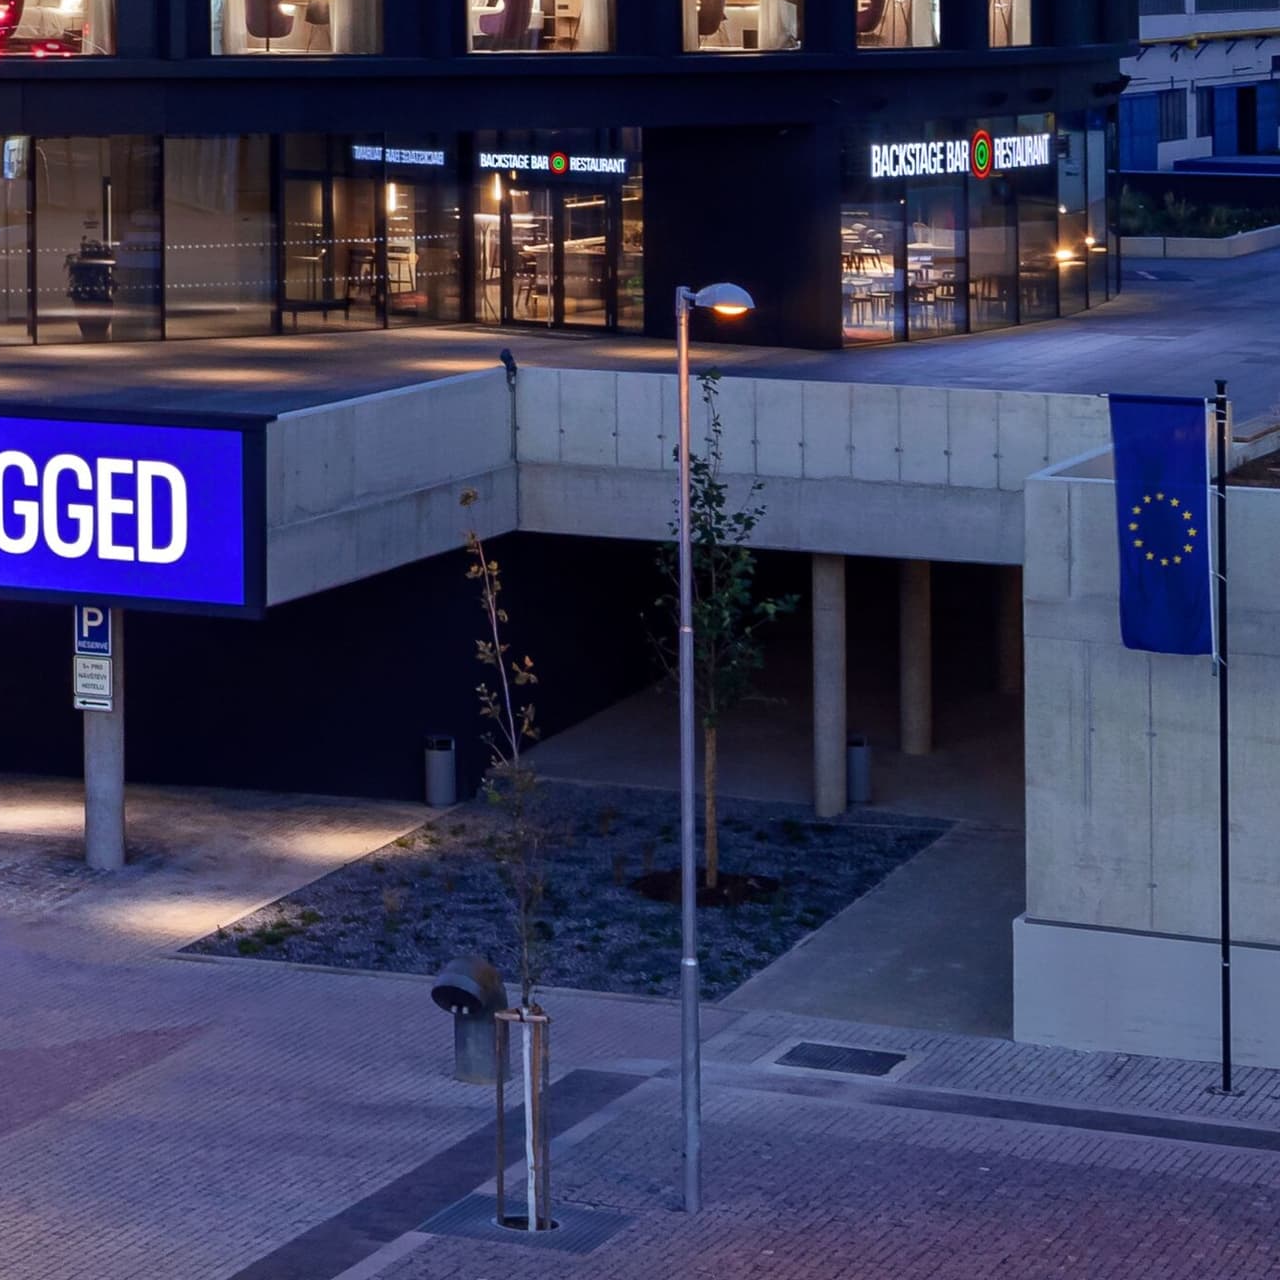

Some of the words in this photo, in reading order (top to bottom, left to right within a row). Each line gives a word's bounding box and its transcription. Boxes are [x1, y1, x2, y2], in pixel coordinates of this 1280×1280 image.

[480, 152, 530, 169] BACKSTAGE
[531, 155, 550, 170] BAR
[569, 156, 627, 173] RESTAURANT
[870, 140, 945, 178] BACKSTAGE
[945, 139, 971, 174] BAR
[993, 133, 1051, 170] RESTAURANT
[82, 607, 104, 637] P
